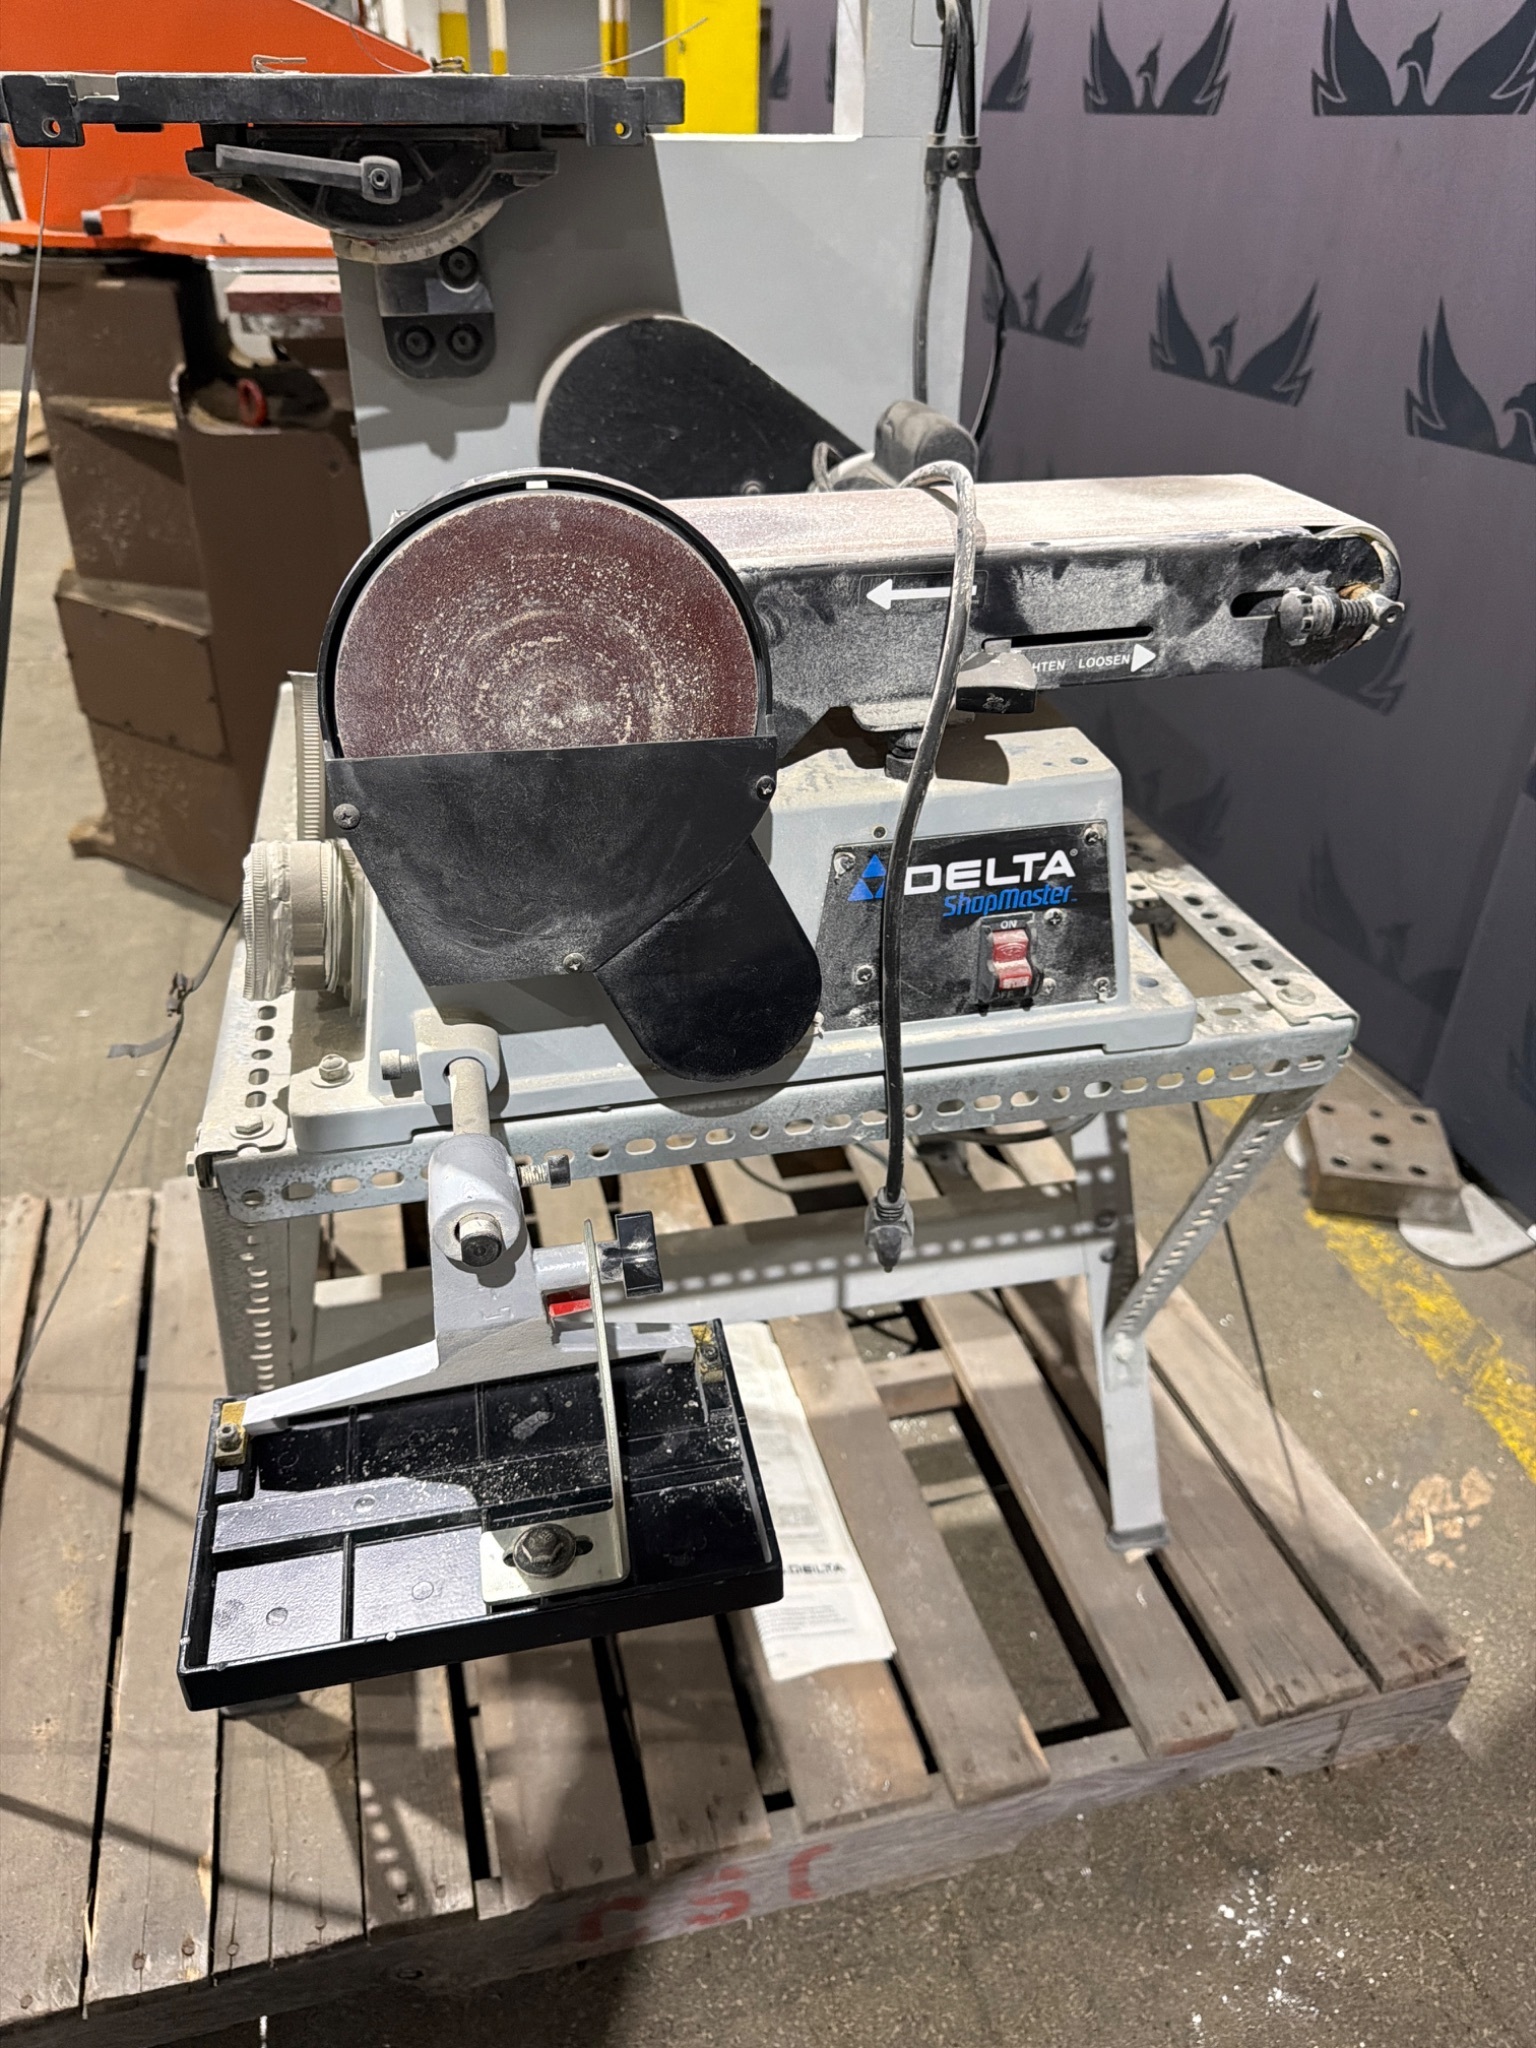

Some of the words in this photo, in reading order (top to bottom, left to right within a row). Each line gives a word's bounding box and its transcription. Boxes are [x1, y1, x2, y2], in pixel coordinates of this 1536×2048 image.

[1078, 653, 1131, 669] LOOSEN
[904, 850, 1076, 896] DELTA
[943, 884, 1073, 917] ShopMaster
[1000, 920, 1018, 929] ON
